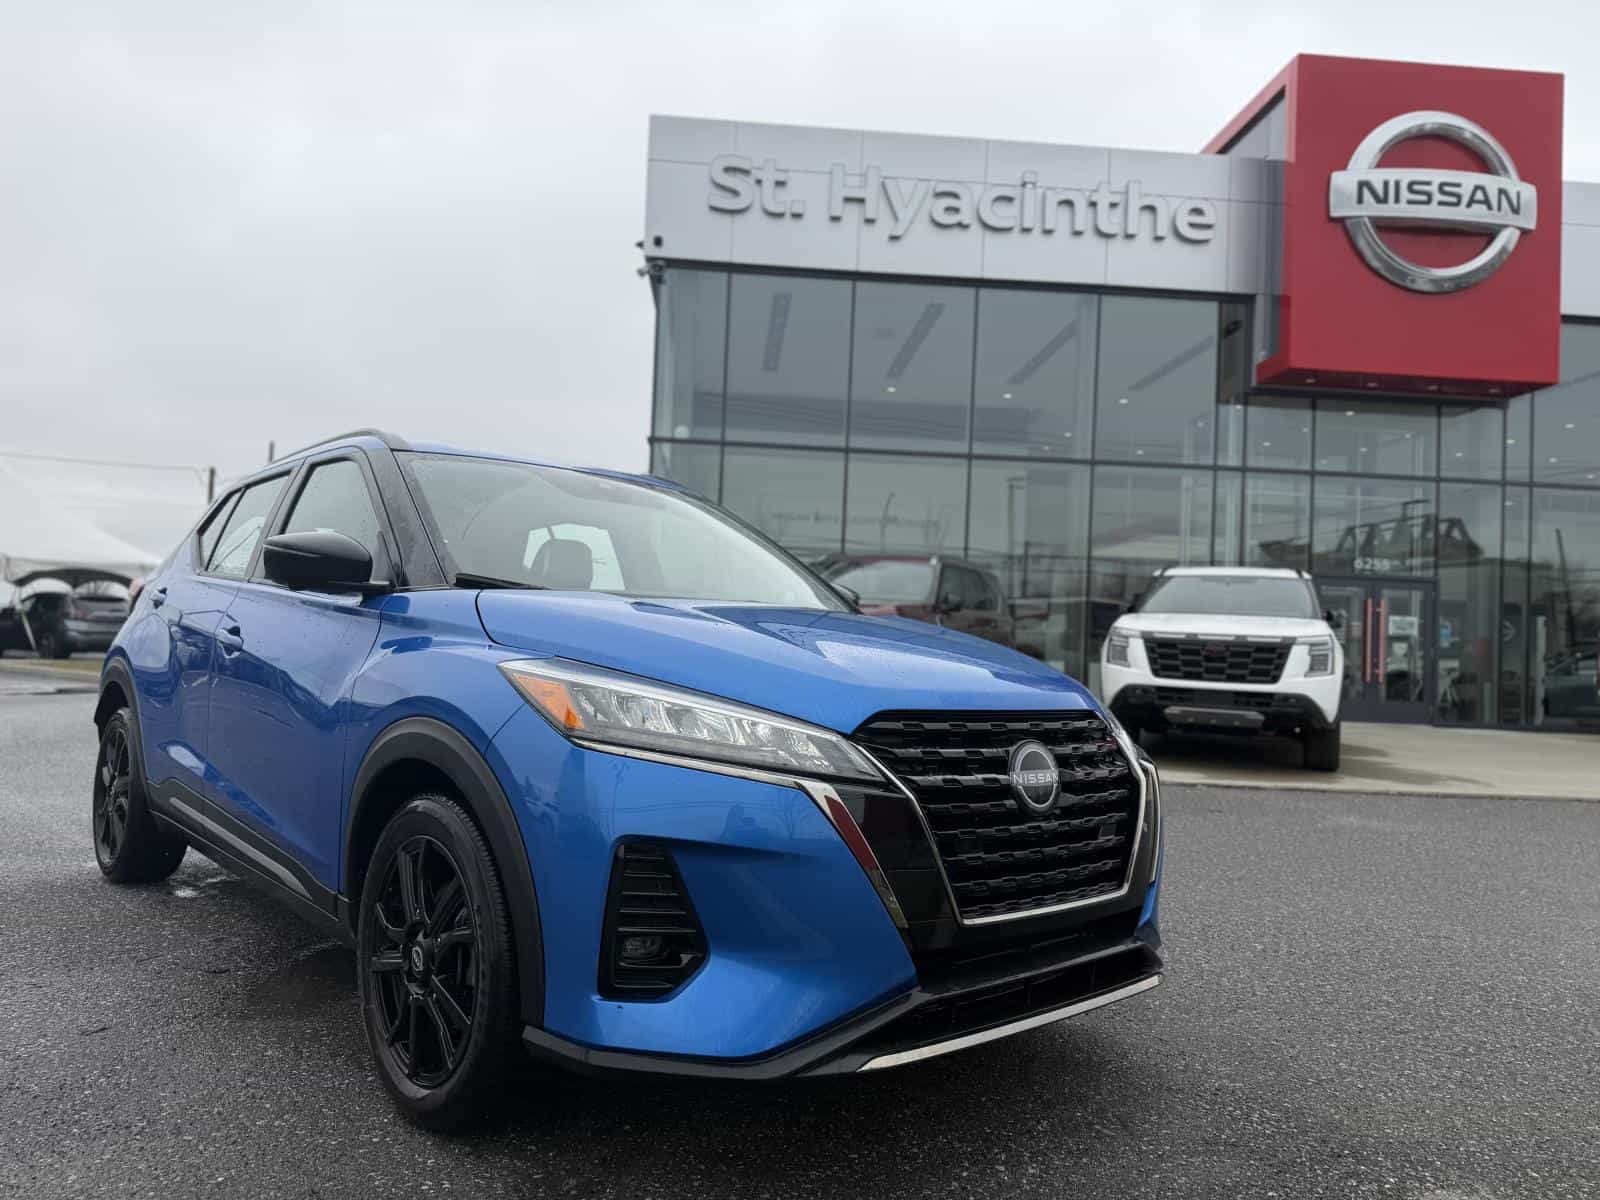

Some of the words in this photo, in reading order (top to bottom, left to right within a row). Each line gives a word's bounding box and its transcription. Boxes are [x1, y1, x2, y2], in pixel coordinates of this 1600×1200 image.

[707, 153, 805, 219] St.
[828, 163, 1219, 244] Hyacinthe
[1356, 179, 1521, 215] NISSAN
[1013, 773, 1059, 785] NISSAN
